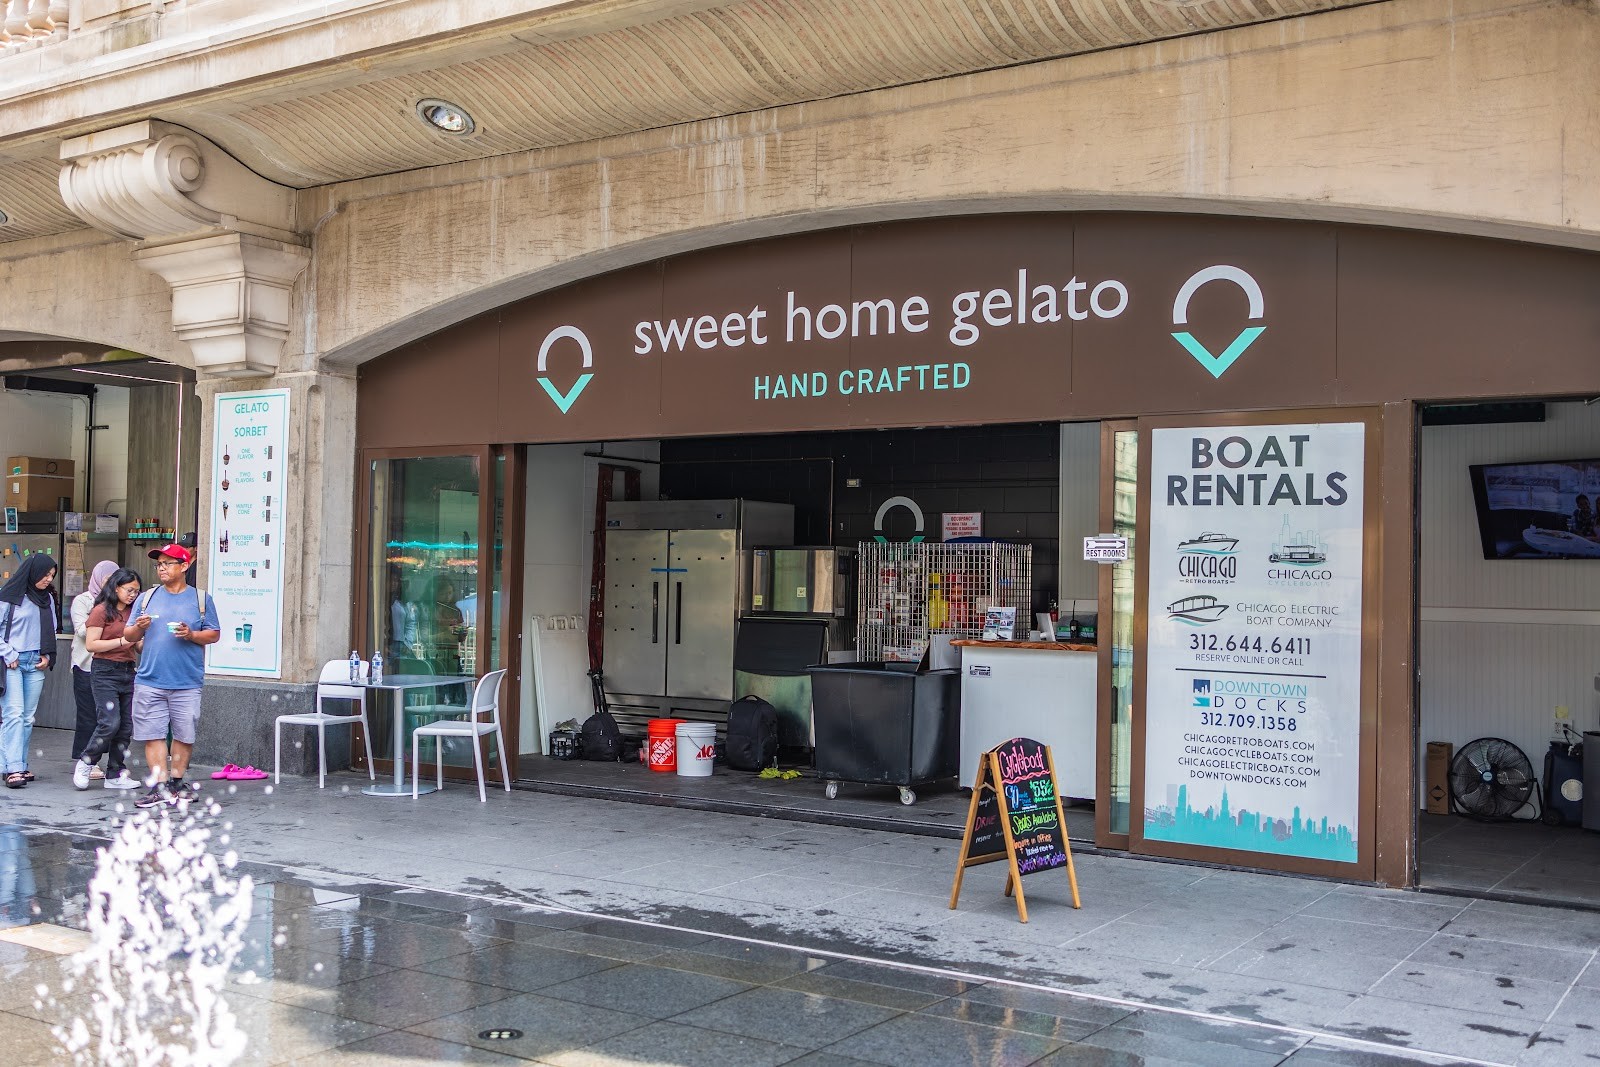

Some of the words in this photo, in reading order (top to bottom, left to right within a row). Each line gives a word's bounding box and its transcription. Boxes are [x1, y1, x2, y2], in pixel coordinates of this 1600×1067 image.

[634, 304, 767, 354] sweet
[785, 291, 930, 342] home
[950, 268, 1129, 347] gelato
[753, 369, 827, 400] HAND
[838, 362, 970, 395] CRAFTED
[234, 402, 269, 414] GELATO
[234, 426, 268, 438] SORBET
[1191, 434, 1310, 469] BOAT
[1167, 470, 1348, 506] RENTALS
[1086, 549, 1101, 557] REST
[1102, 549, 1126, 558] ROOMS
[1178, 556, 1236, 578] CHICAGO
[1268, 569, 1332, 580] CHICAGO
[1268, 580, 1331, 588] CYCLEBOATS
[1236, 602, 1286, 614] CHICAGO
[1291, 604, 1339, 616] ELECTRIC
[1246, 615, 1274, 626] BOAT
[1278, 616, 1332, 628] COMPANY
[1190, 633, 1311, 655] 312.644.6411
[1195, 654, 1231, 663] RESERVE
[1233, 655, 1265, 665] ONLINE
[1267, 656, 1280, 665] OR
[1282, 657, 1304, 667] CALL
[1214, 680, 1307, 696] DOWNTOWN
[1214, 696, 1307, 714] DOCKS
[1201, 712, 1297, 732] 312.709.1358
[650, 738, 674, 764] HOME
[1184, 733, 1315, 751] CHICAGORETROBOATS.COM
[657, 748, 674, 764] DEPOT
[1185, 745, 1314, 764] CHICAGOCYCLEBOATS.COM
[1178, 756, 1320, 776] CHICAGOELECTRICBOATS.COM
[1190, 770, 1307, 788] DOWNTOWNDOCKS.COM
[1012, 814, 1032, 835] Seats
[1032, 810, 1058, 826] Available
